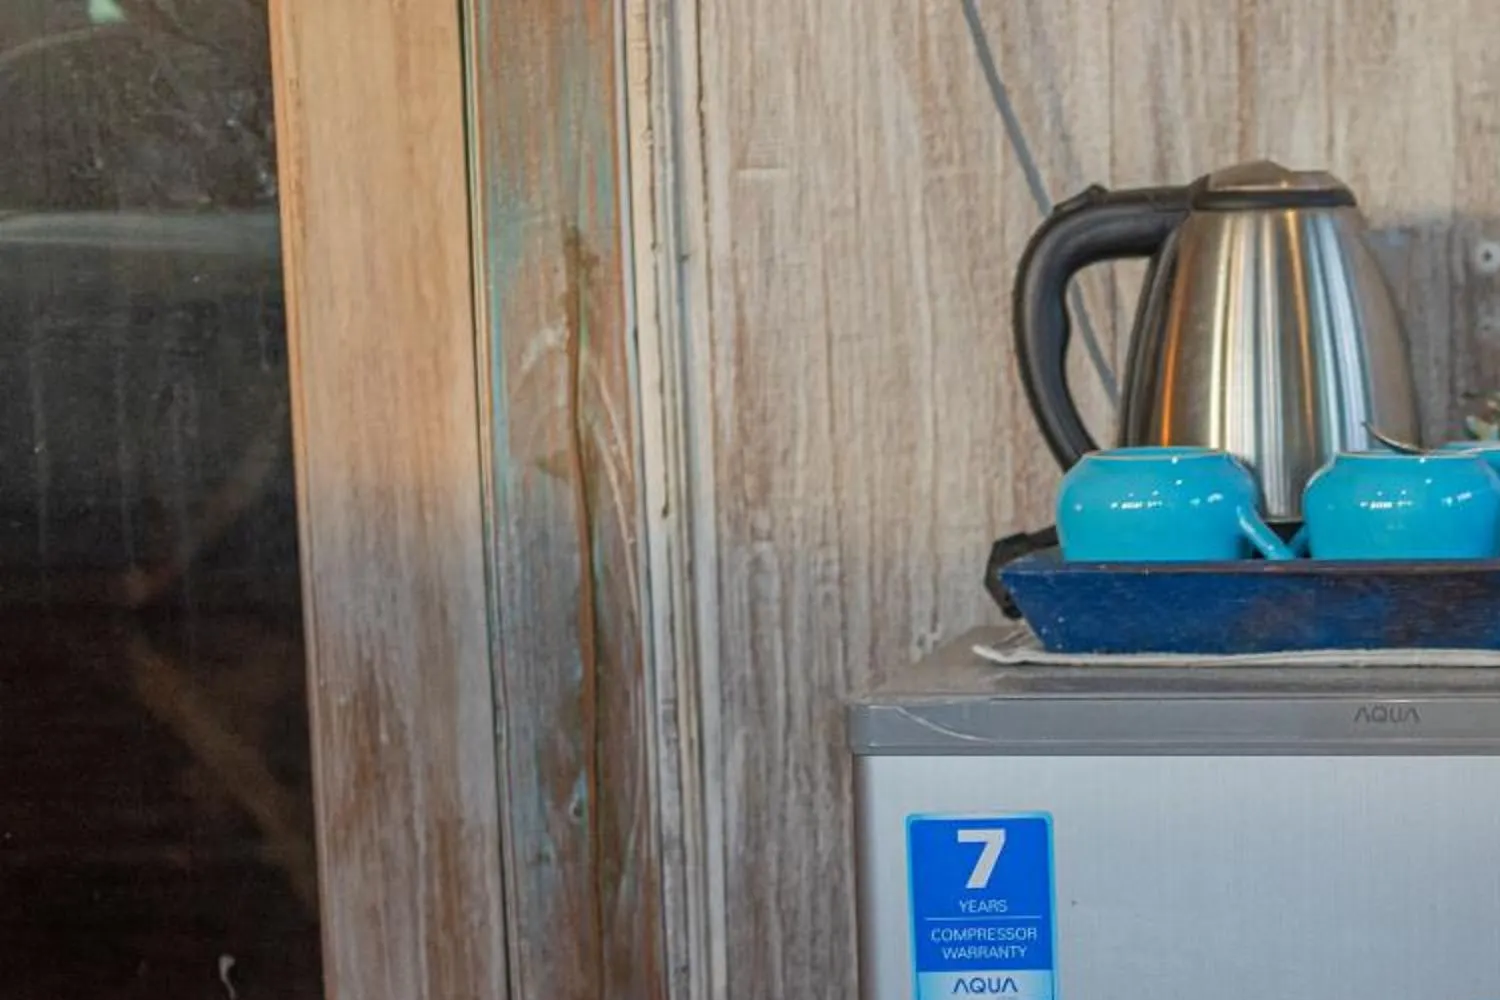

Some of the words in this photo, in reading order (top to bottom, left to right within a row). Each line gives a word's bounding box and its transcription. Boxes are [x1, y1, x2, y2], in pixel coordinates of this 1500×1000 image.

[1353, 705, 1422, 723] AQUA
[956, 828, 1007, 889] 7
[958, 899, 1009, 914] YEARS
[930, 927, 1038, 943] COMPRESSOR
[941, 945, 1029, 961] WARRANTY
[952, 976, 1019, 994] AQUA
